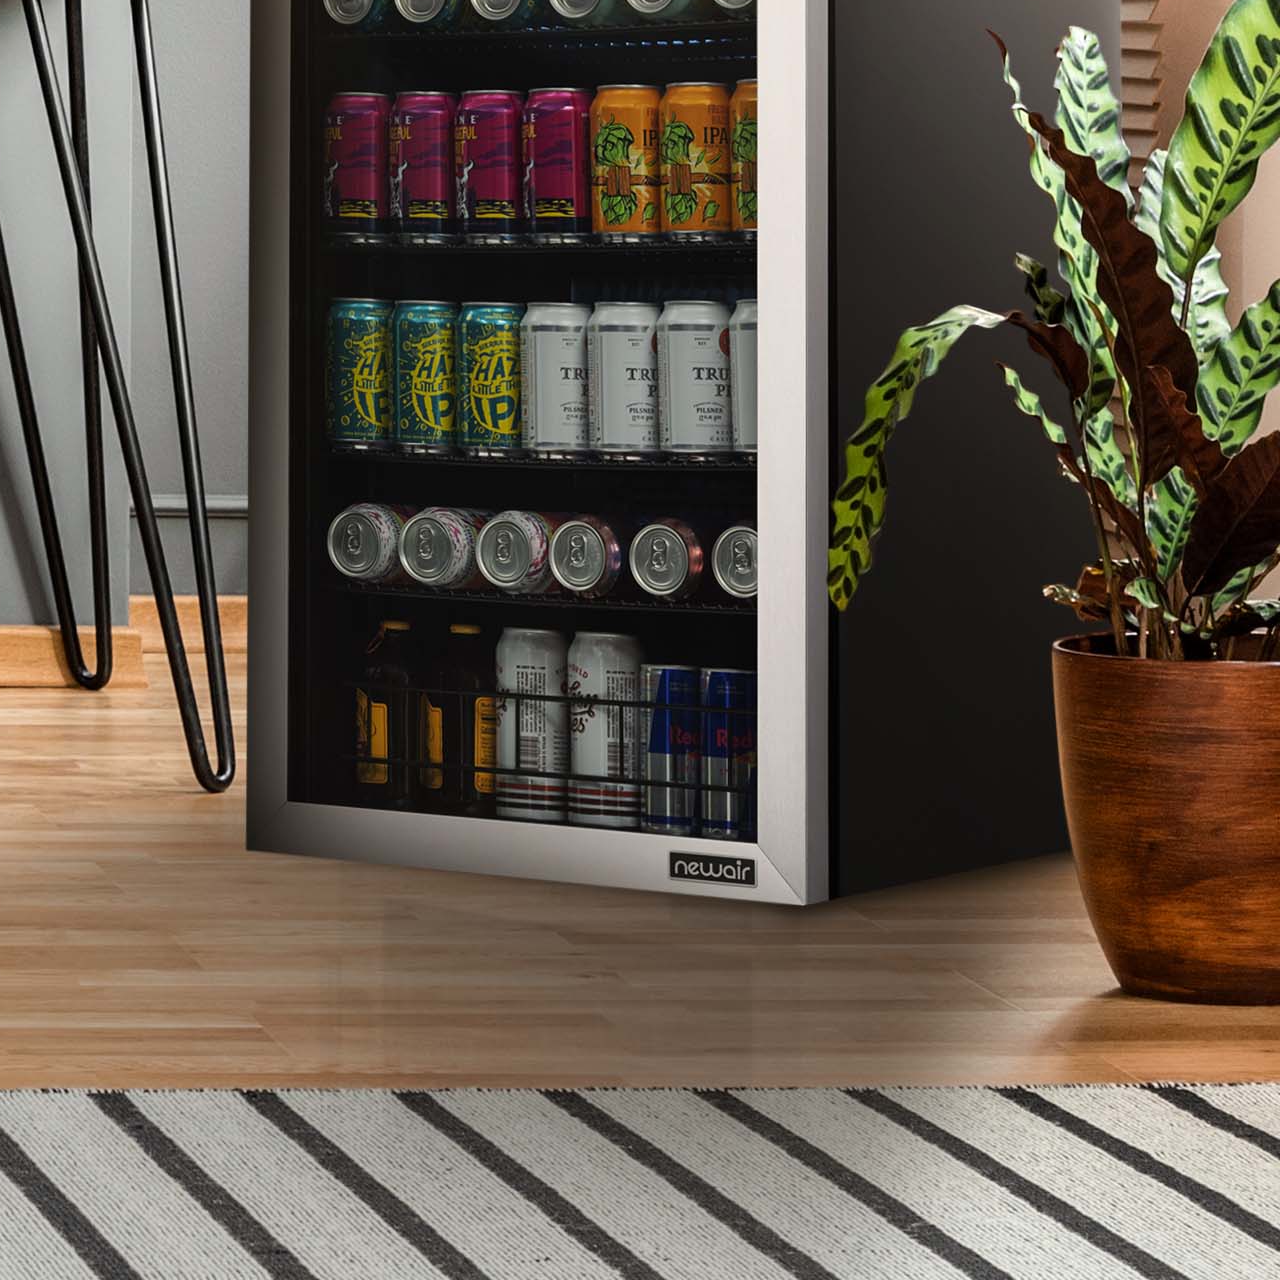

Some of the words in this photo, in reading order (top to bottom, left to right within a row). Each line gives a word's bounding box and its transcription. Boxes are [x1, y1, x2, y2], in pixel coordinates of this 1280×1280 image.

[703, 126, 729, 144] IPA
[692, 367, 730, 381] TRU
[674, 859, 751, 881] newair
